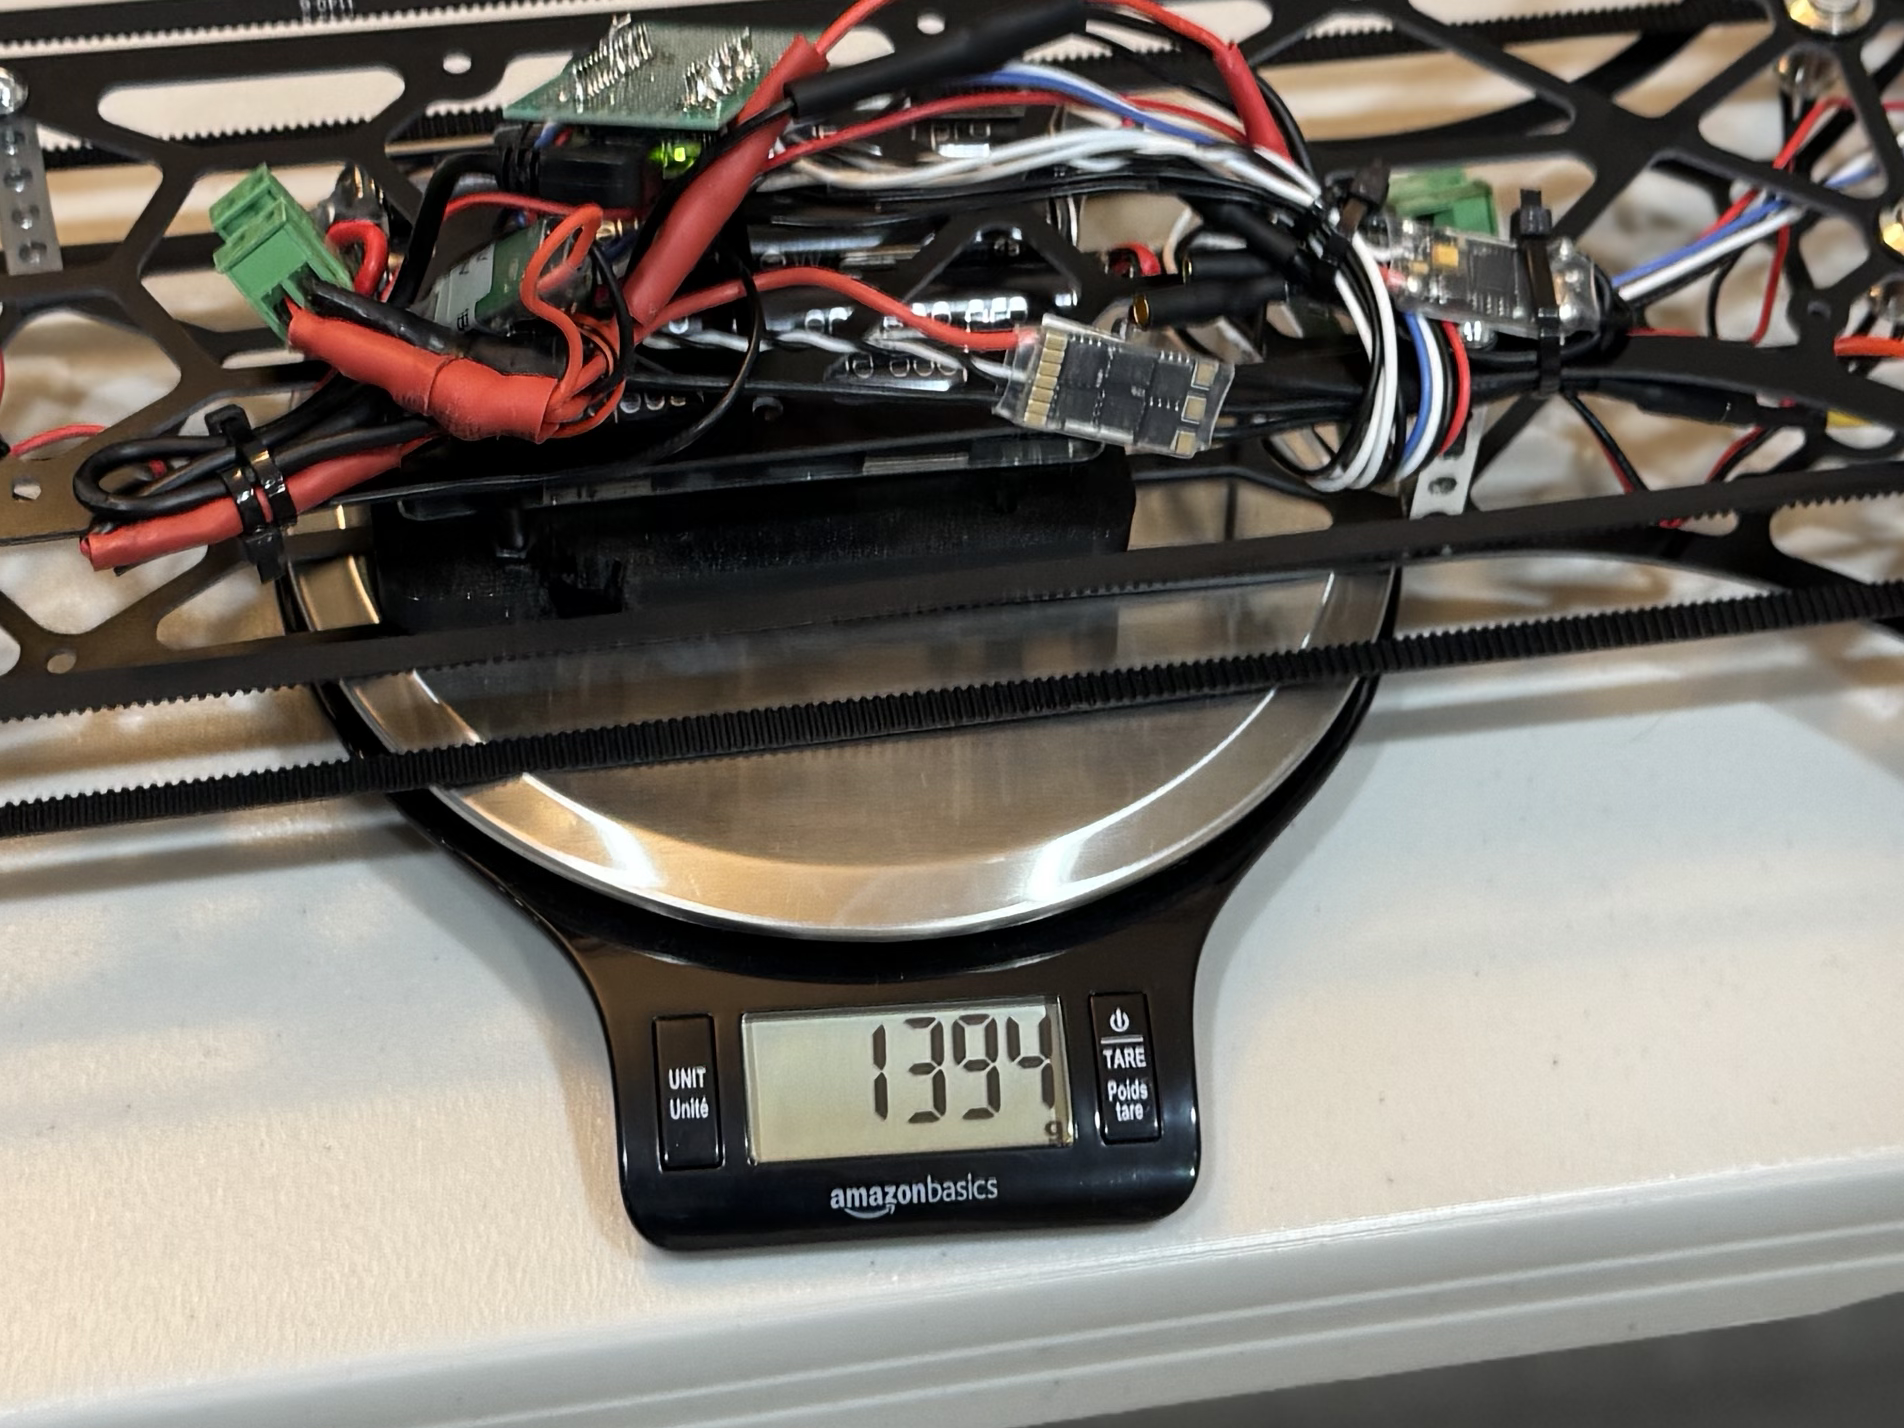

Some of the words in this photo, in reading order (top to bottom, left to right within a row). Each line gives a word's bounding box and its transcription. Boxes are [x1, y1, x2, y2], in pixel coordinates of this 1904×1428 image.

[872, 1013, 1056, 1122] 1394
[1102, 1047, 1147, 1070] TARE
[669, 1067, 707, 1091] UNIT
[1108, 1079, 1149, 1102] Poids
[670, 1095, 710, 1121] Unité
[1115, 1101, 1146, 1122] tare
[830, 1174, 998, 1212] amazonbasics
